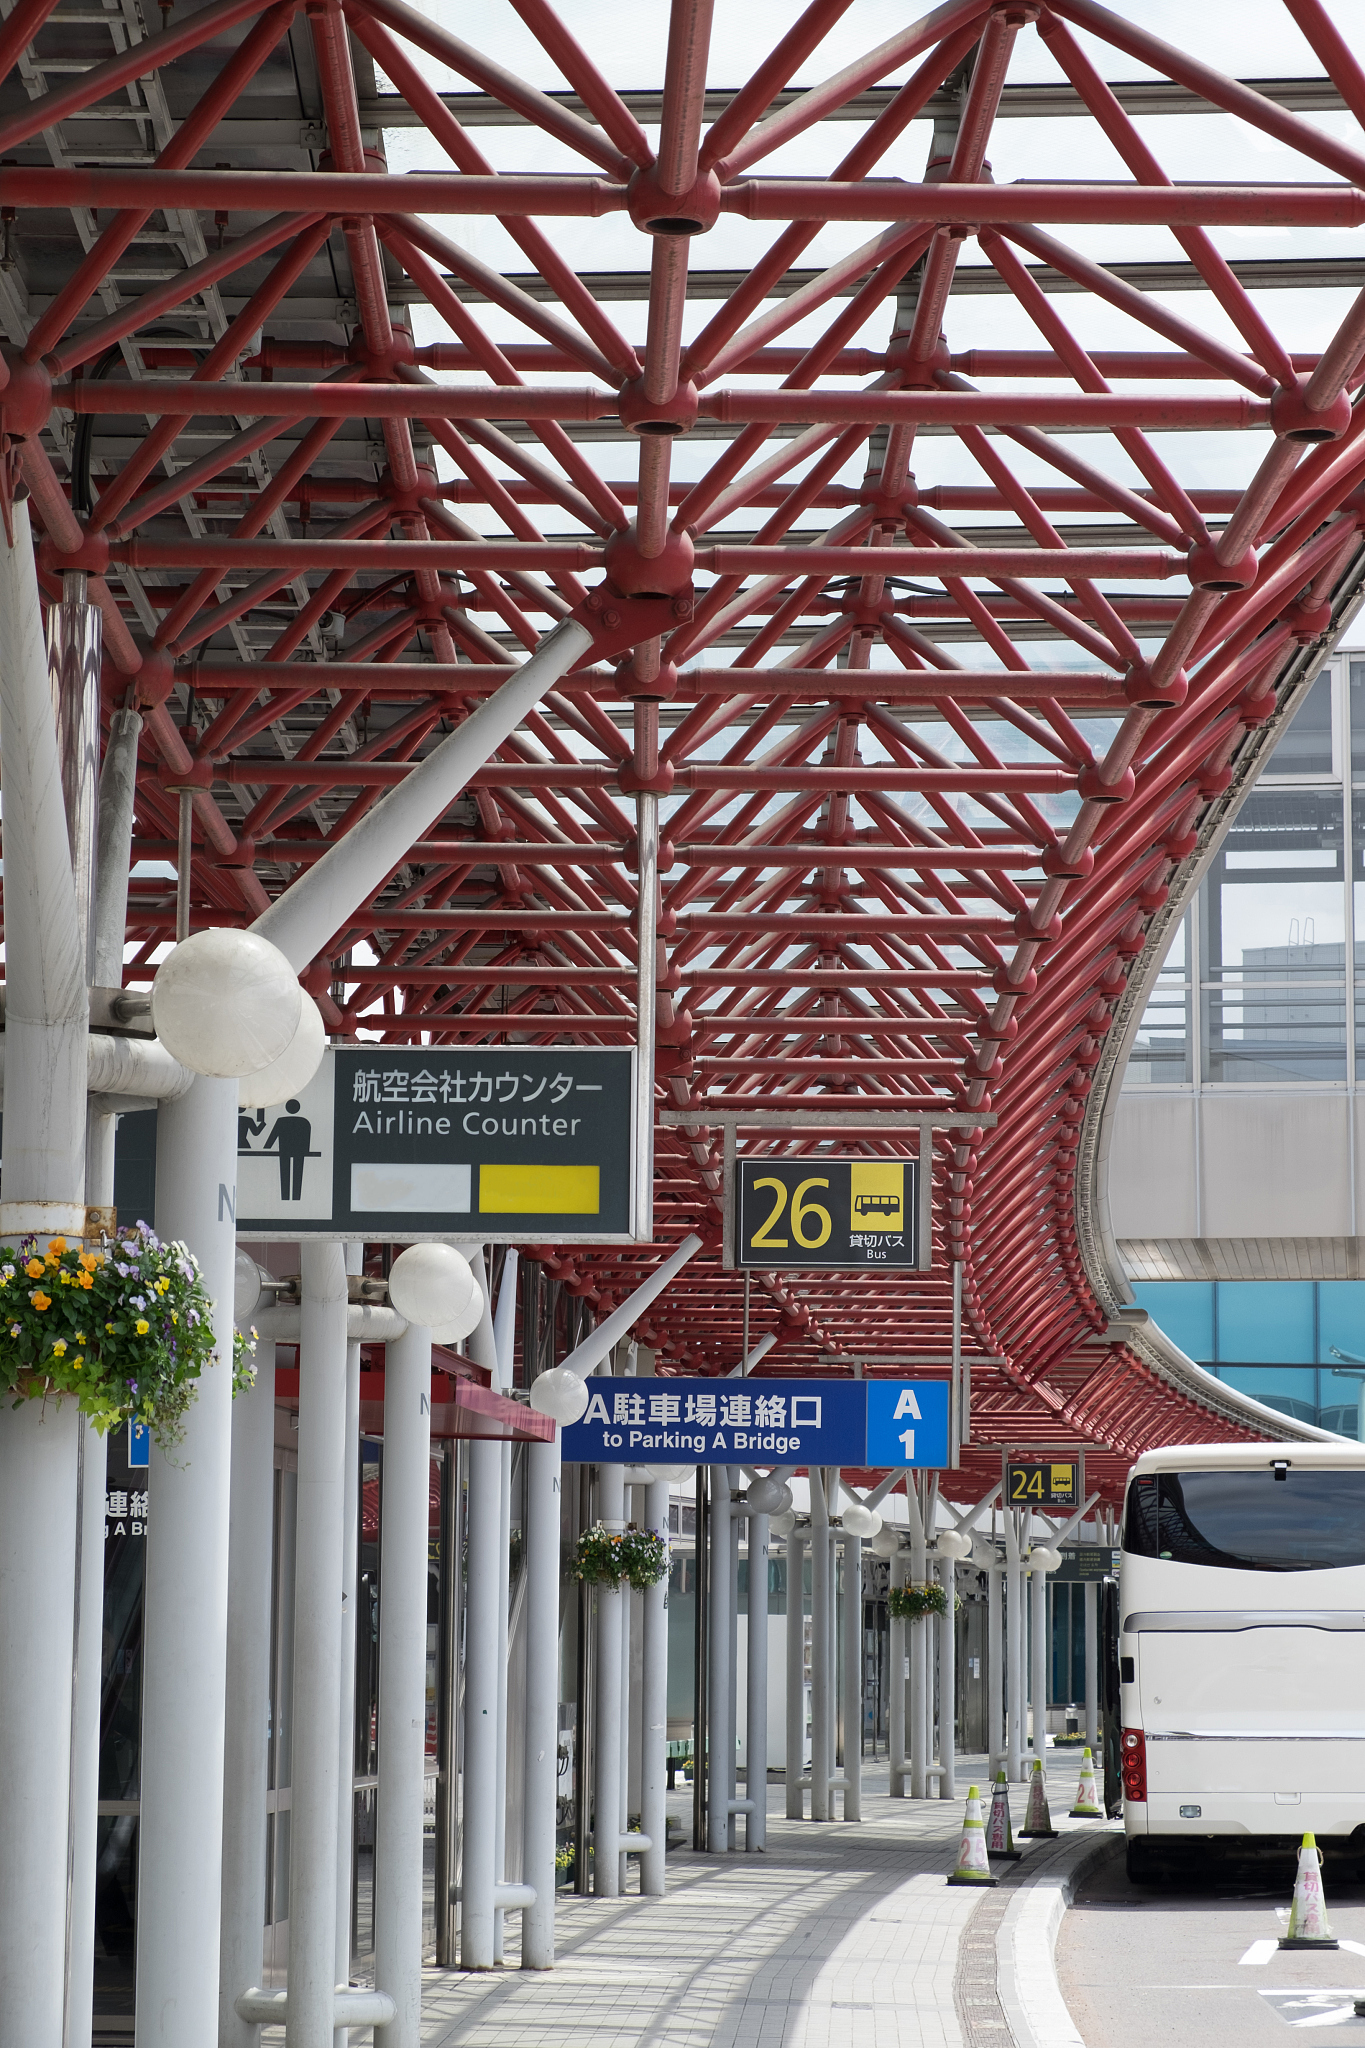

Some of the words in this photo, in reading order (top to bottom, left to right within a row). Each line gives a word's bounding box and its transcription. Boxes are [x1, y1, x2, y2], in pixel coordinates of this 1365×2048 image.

[352, 1069, 603, 1104] 航空会社カウンター
[352, 1110, 451, 1134] Airline
[462, 1112, 582, 1136] Counter
[750, 1177, 832, 1249] 26
[849, 1234, 905, 1248] 貸切バス
[866, 1250, 887, 1259] Bus
[583, 1393, 822, 1429] A駐車場連絡口
[893, 1389, 923, 1420] A
[602, 1431, 623, 1447] to
[629, 1431, 706, 1453] Parking
[712, 1432, 727, 1449] A
[733, 1432, 801, 1454] Bridge
[898, 1429, 915, 1460] 1
[1012, 1470, 1045, 1499] 24
[1077, 1784, 1096, 1803] 24
[960, 1837, 986, 1867] 25
